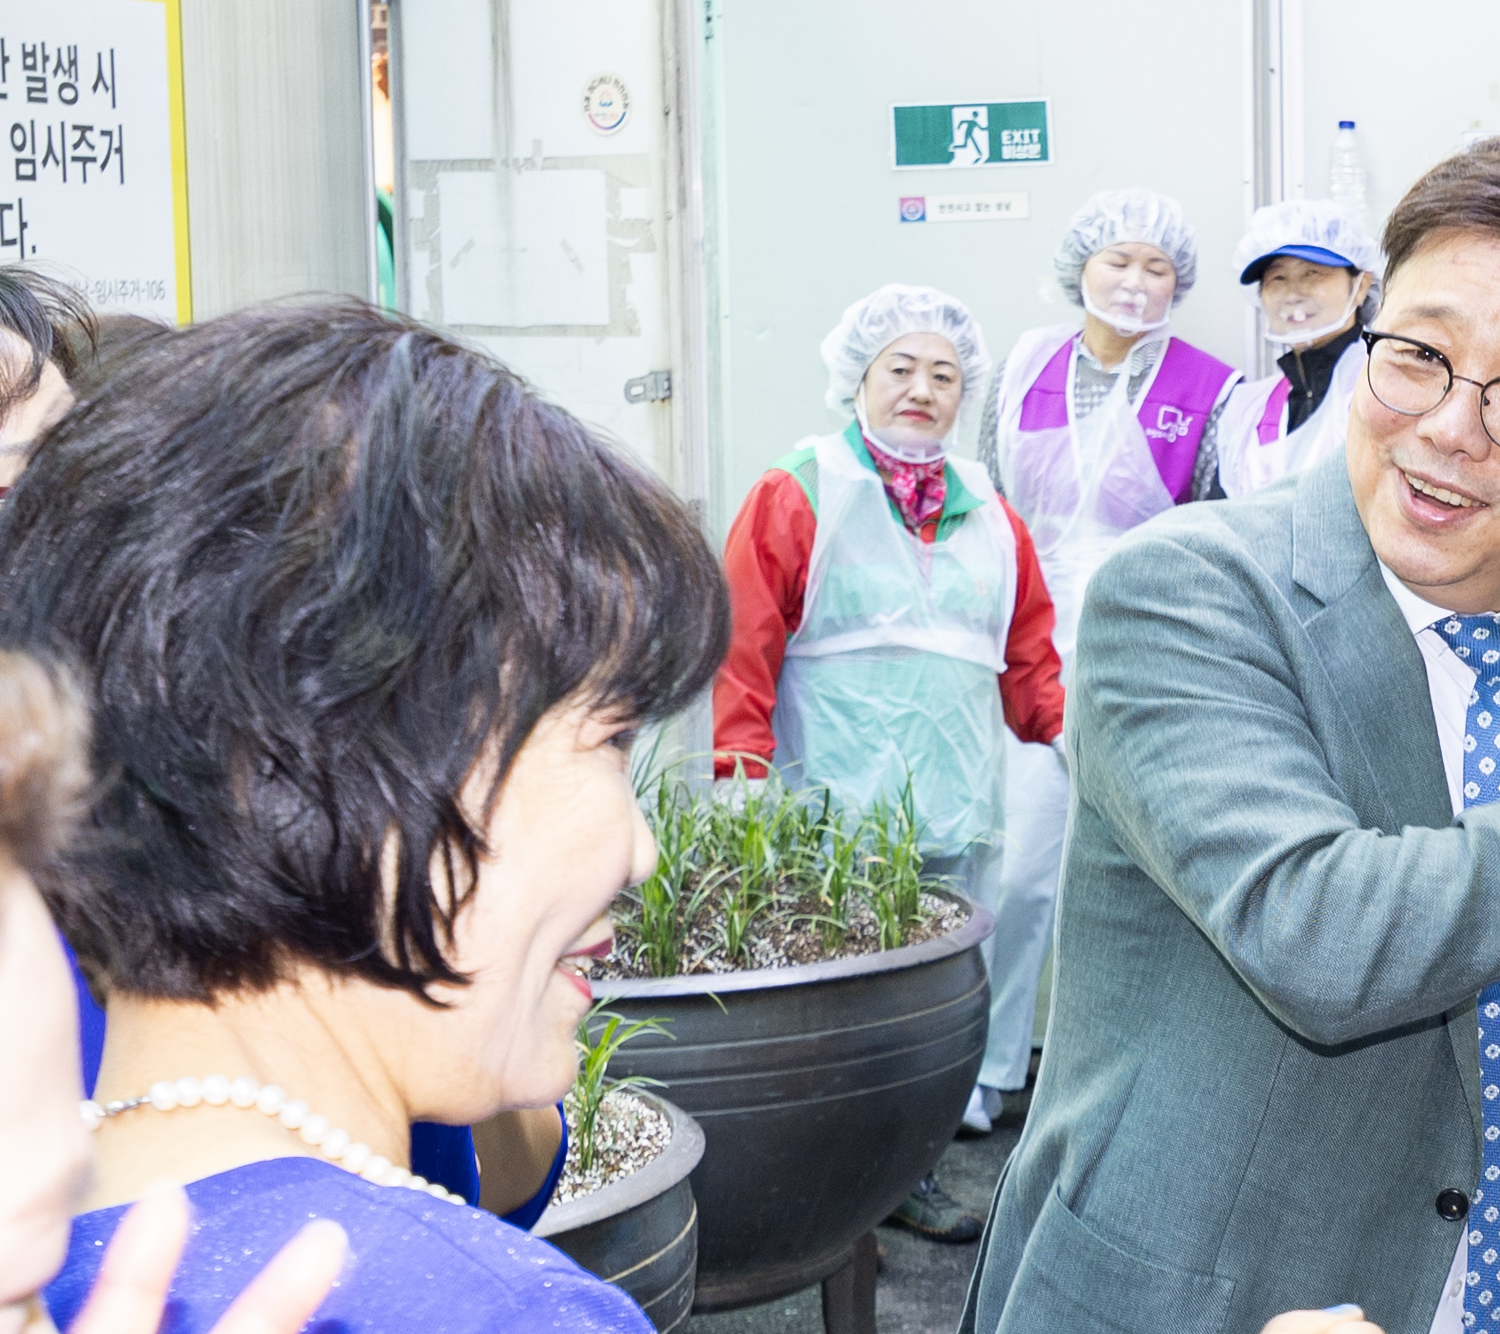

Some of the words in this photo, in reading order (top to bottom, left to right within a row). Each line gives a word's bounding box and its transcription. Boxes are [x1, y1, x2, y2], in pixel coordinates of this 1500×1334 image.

[21, 41, 80, 106] 발생
[90, 47, 117, 110] 시
[9, 119, 125, 185] 임시주거
[1001, 128, 1041, 144] EXIT
